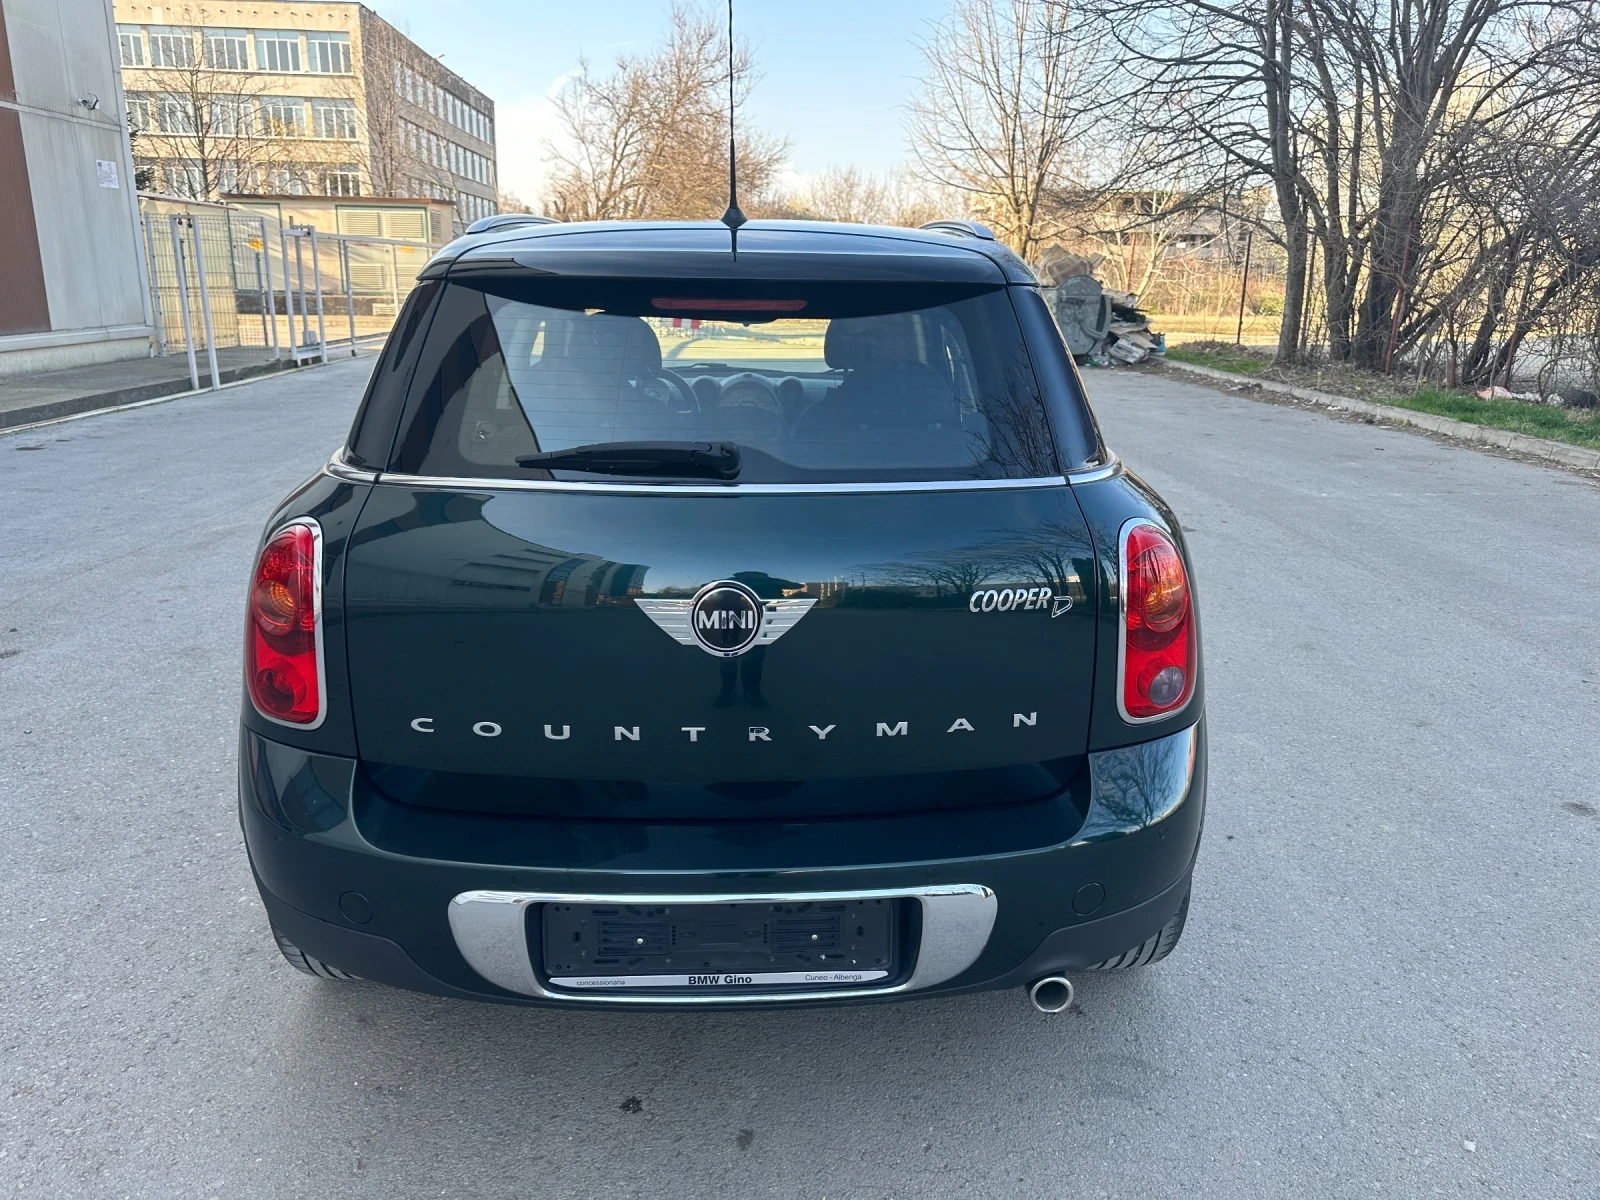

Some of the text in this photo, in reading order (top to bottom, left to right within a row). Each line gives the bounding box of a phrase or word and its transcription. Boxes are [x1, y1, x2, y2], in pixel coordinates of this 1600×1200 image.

[969, 587, 1073, 618] COOPER D
[698, 610, 753, 630] MINI
[410, 711, 1039, 742] COUNTRYMAN
[688, 975, 753, 985] BMW Gino
[834, 973, 862, 982] Albenga
